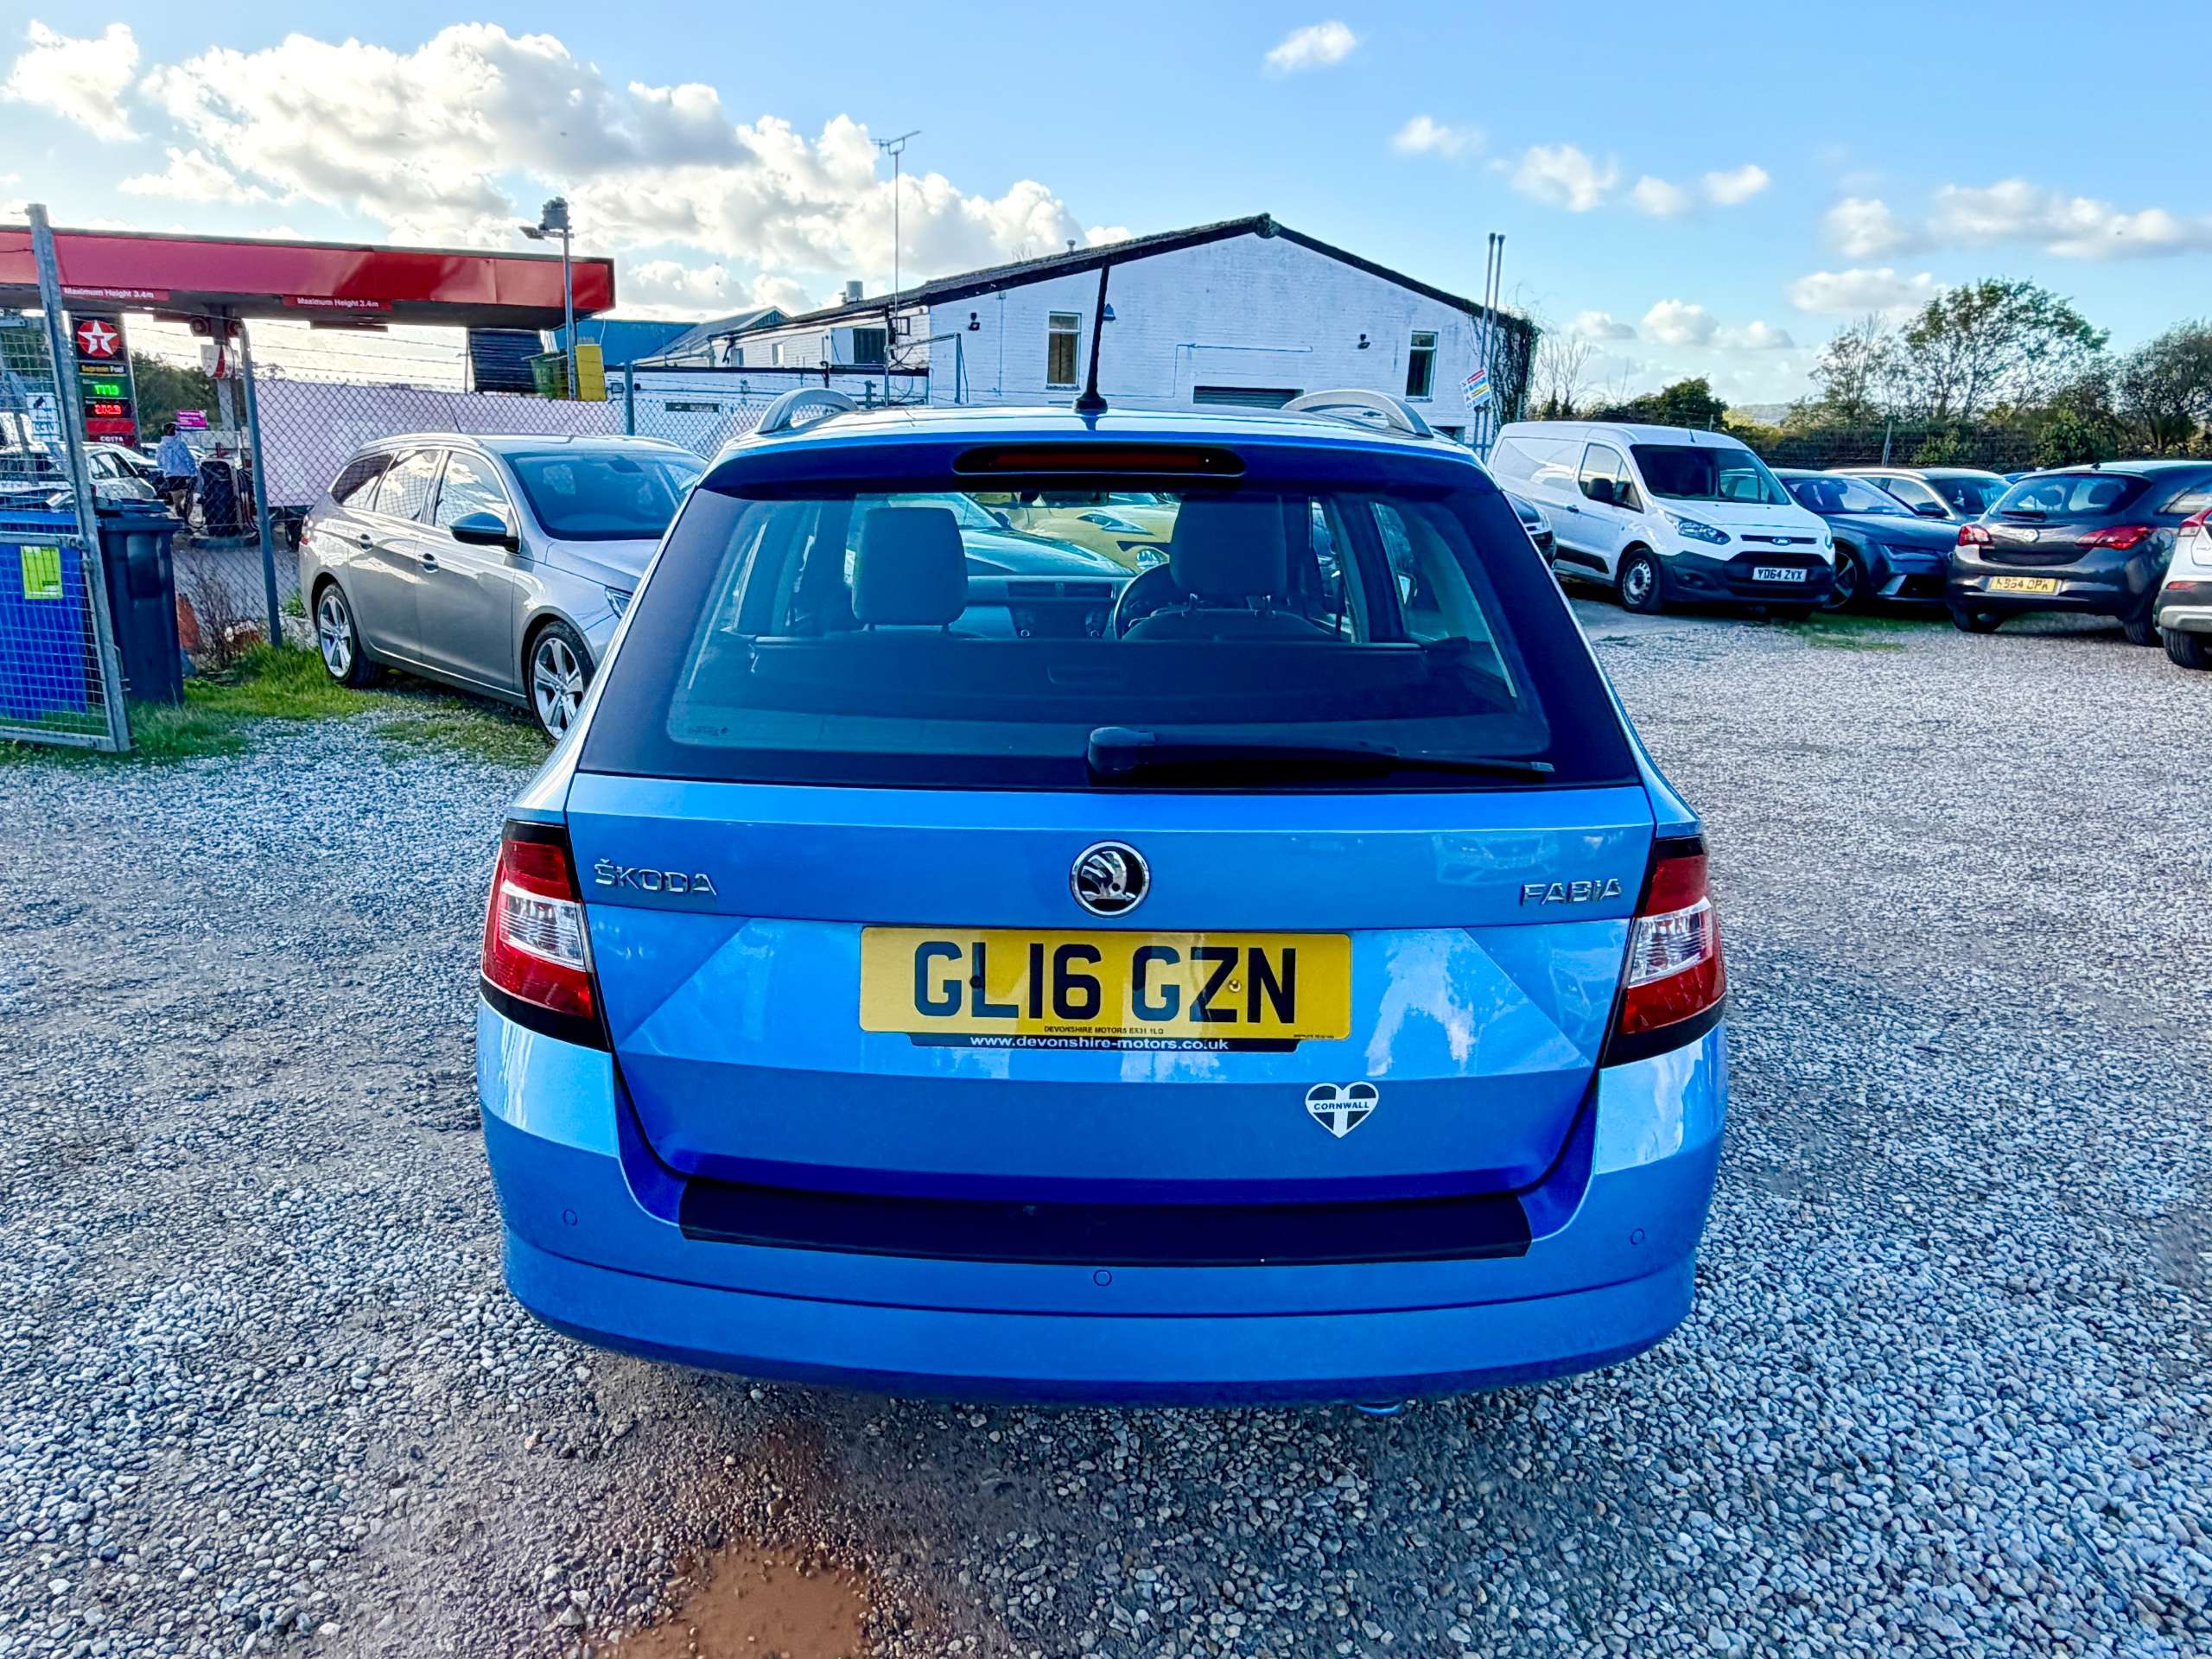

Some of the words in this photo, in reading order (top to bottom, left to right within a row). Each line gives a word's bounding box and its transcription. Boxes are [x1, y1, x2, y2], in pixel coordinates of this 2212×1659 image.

[64, 287, 104, 296] Maximum
[105, 289, 131, 299] Height
[296, 297, 333, 306] Maximum
[334, 299, 359, 308] Height
[594, 858, 717, 896] ŠKODA
[1520, 879, 1623, 906] FABIA
[913, 940, 1102, 1020] GL16
[1131, 944, 1296, 1024] GZN
[970, 1036, 1229, 1051] www.devonshire-motors.co.uk
[1313, 1101, 1370, 1110] CORNWALL
